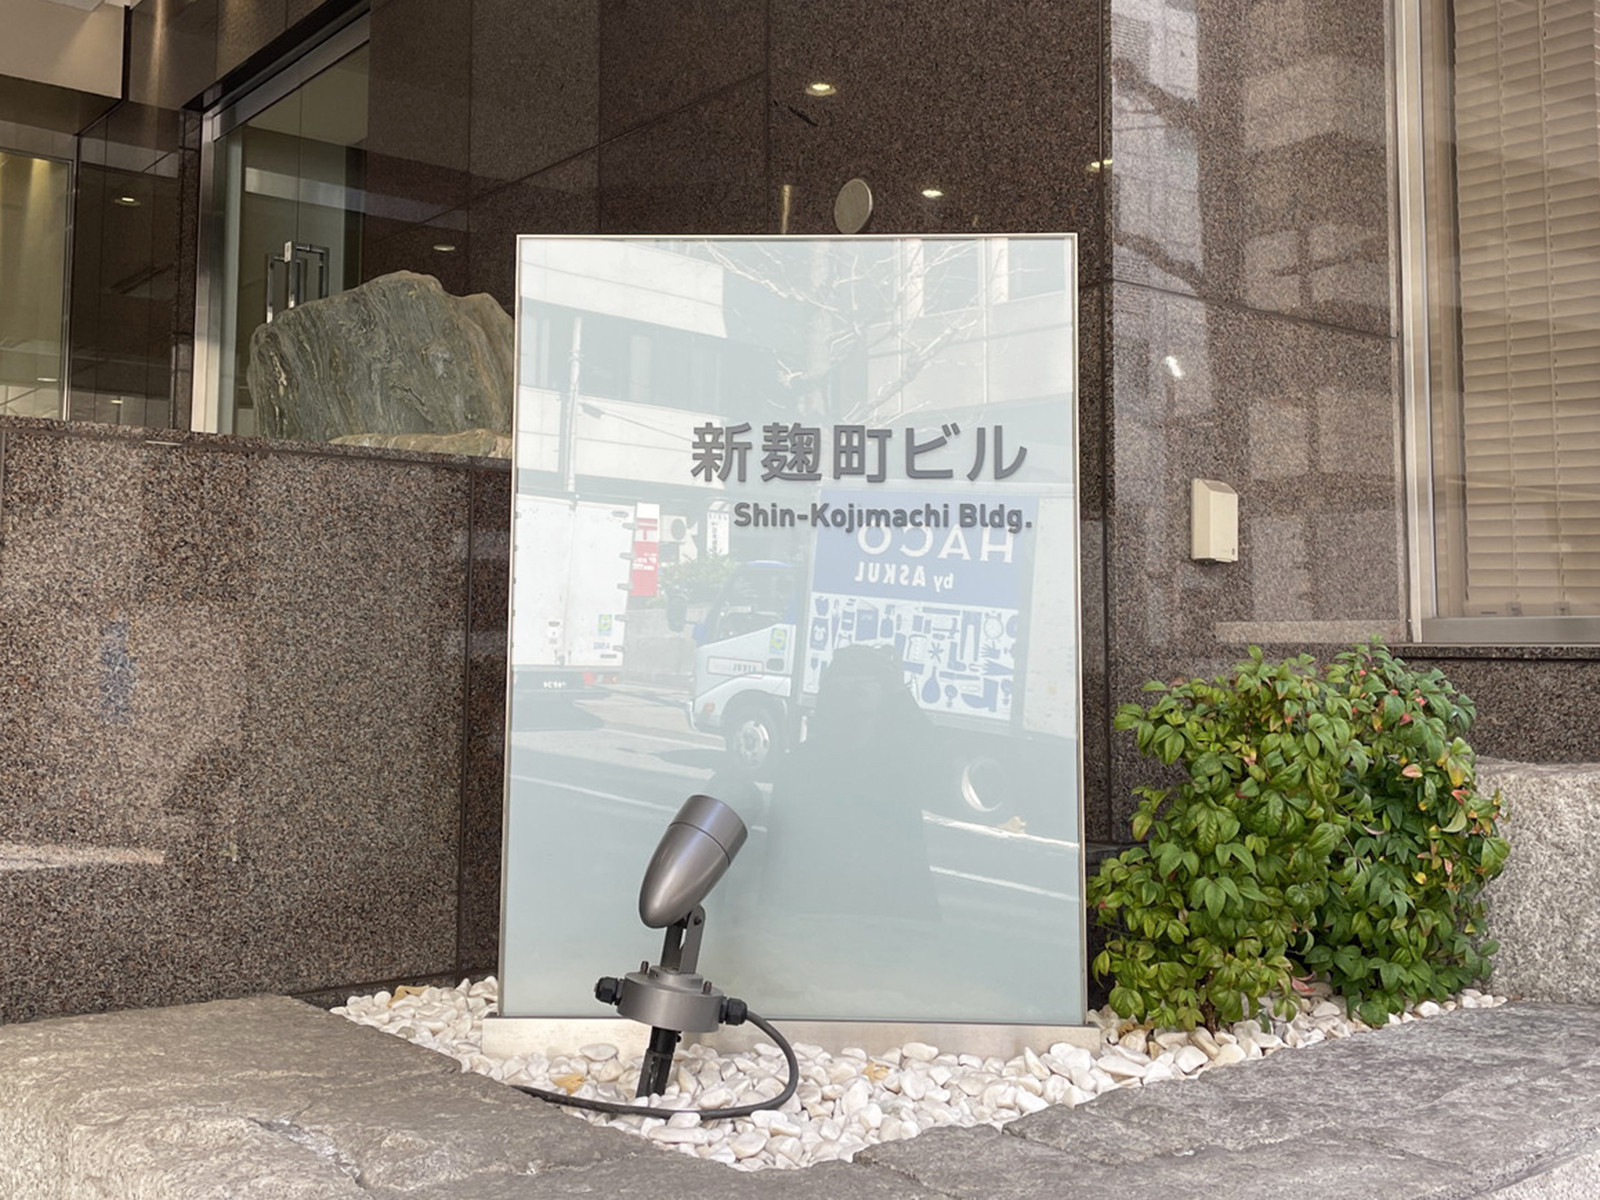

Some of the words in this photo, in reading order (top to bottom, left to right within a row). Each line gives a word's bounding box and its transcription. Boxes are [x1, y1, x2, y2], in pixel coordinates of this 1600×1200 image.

[690, 421, 1028, 483] 新麹町ビル
[734, 502, 950, 534] Shin-Kojimachi
[958, 503, 1033, 534] Bldg.
